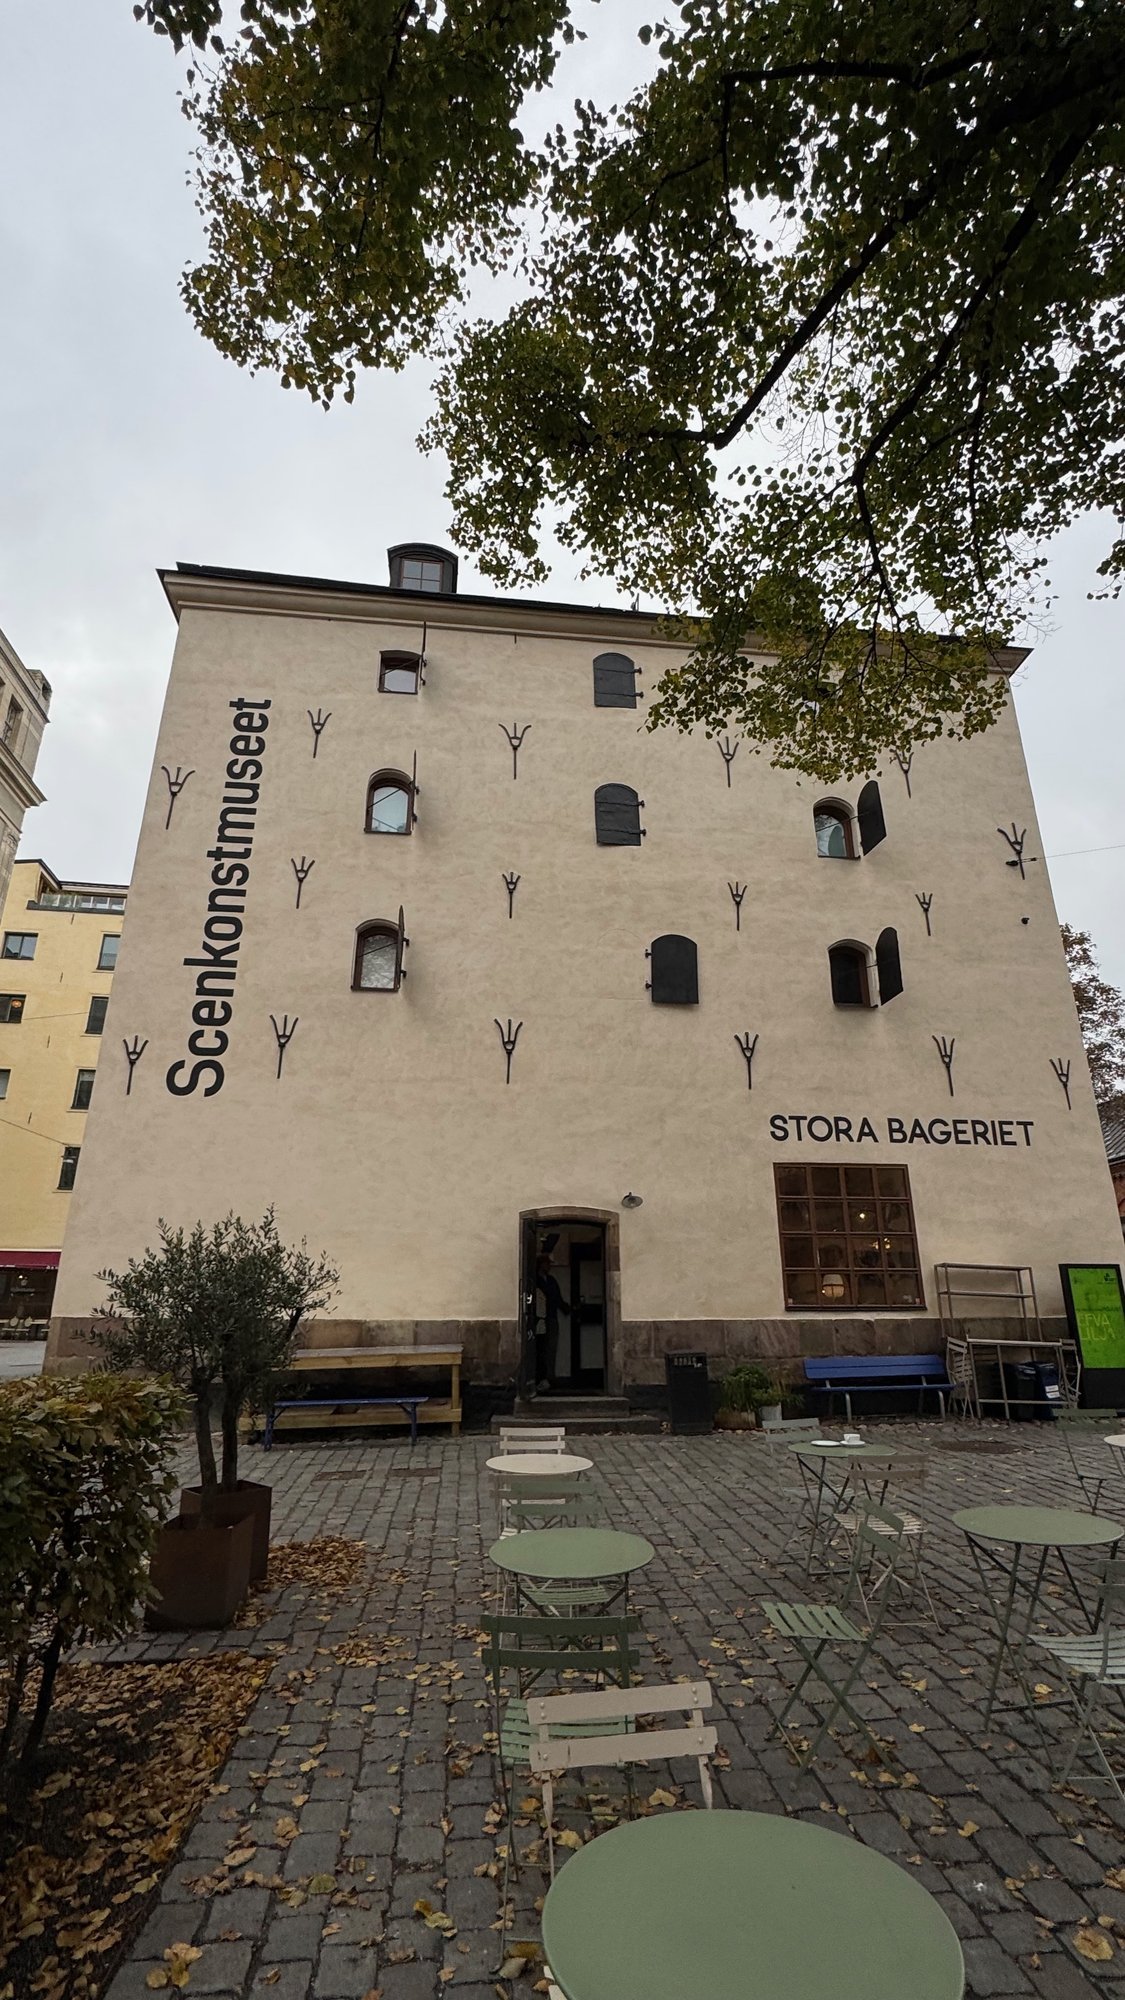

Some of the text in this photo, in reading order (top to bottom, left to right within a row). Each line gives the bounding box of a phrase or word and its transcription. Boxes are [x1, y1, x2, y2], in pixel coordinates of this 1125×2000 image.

[166, 698, 272, 1098] Scenkonstmuseet
[770, 1115, 1034, 1147] STORA BAGERIET
